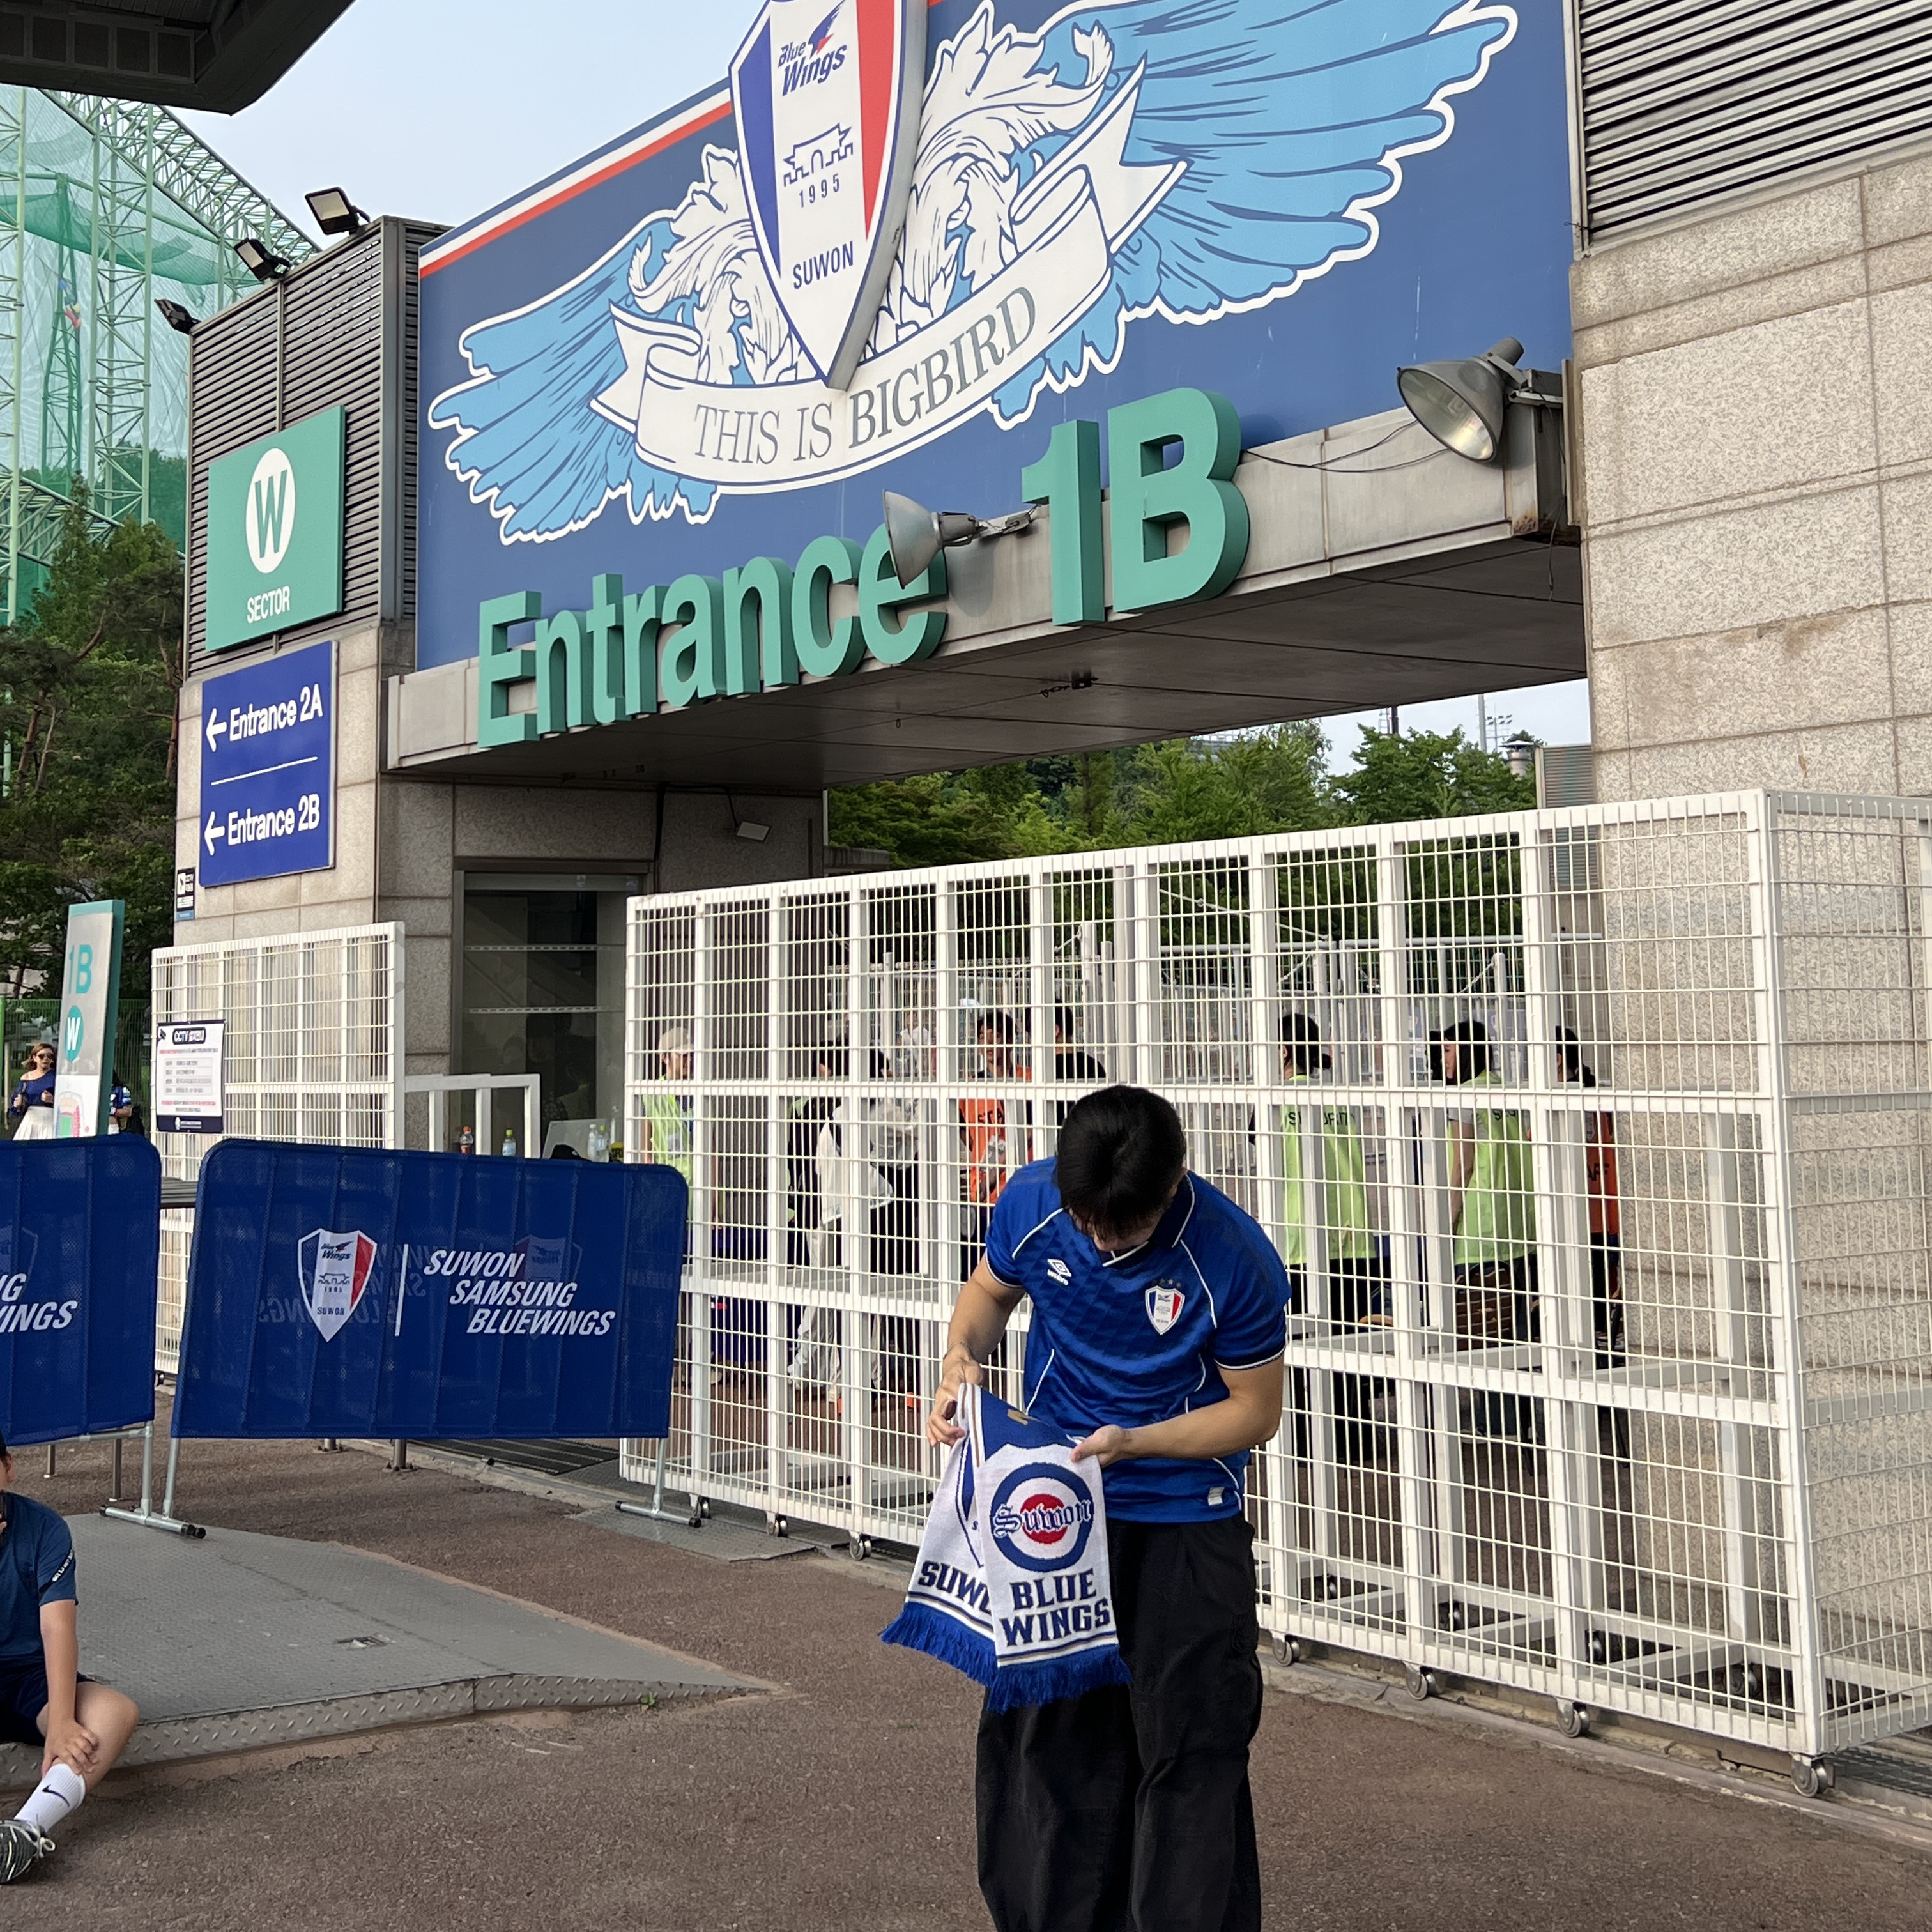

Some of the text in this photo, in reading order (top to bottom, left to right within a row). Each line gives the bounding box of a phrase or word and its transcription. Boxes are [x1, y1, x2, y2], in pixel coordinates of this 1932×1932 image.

[778, 41, 806, 68] Blue
[782, 45, 847, 96] Wings
[799, 173, 840, 208] 1995
[793, 241, 854, 289] SUWON
[694, 287, 1036, 464] THIS IS BIGBIRD
[254, 469, 288, 559] W
[478, 388, 1250, 748] Entrance 1B
[247, 586, 290, 624] SECTOR
[229, 683, 323, 741] Entrance 2A
[228, 793, 320, 846] Entrance 2B
[68, 944, 93, 994] 1B
[68, 1017, 80, 1050] W
[321, 1250, 352, 1261] Wings
[424, 1250, 525, 1278] SUWON
[317, 1307, 345, 1315] SUWON
[450, 1280, 578, 1307] SAMSUNG
[466, 1309, 616, 1335] BLUEWINGS
[993, 1499, 1092, 1538] Suwon
[1009, 1568, 1097, 1611] BLUE
[999, 1597, 1110, 1646] WINGS
